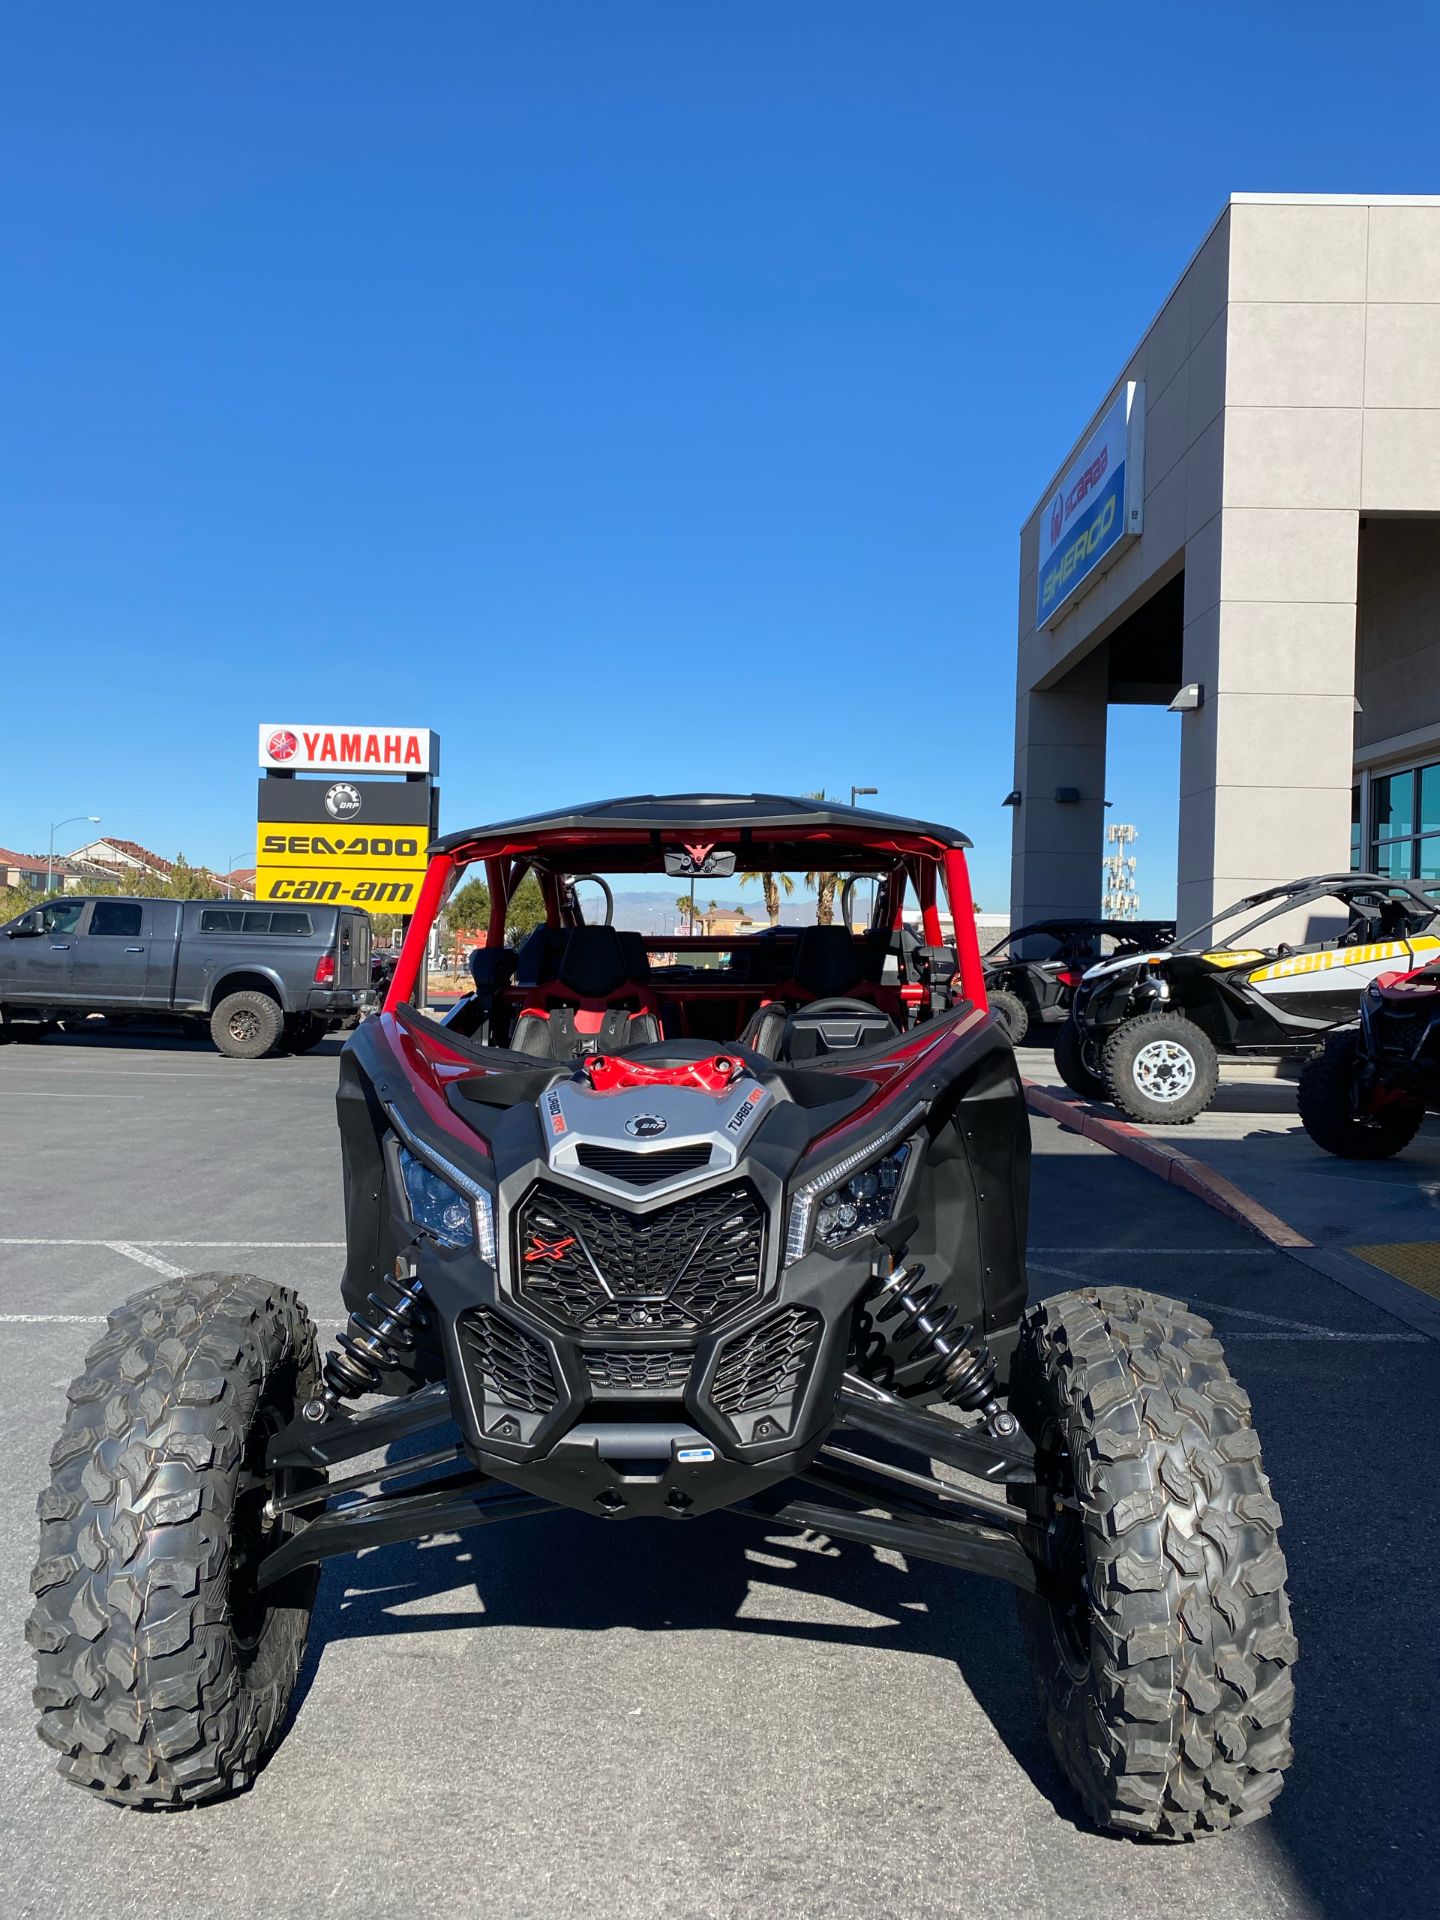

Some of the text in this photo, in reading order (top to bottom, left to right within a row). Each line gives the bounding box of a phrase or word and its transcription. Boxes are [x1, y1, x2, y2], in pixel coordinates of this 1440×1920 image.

[1043, 494, 1116, 605] SHERCO
[303, 732, 421, 764] YAMAHA
[339, 801, 360, 809] BRP
[268, 879, 414, 902] can-am
[547, 1090, 561, 1115] TURBO
[640, 1122, 665, 1130] BRP
[728, 1101, 754, 1131] TURBO
